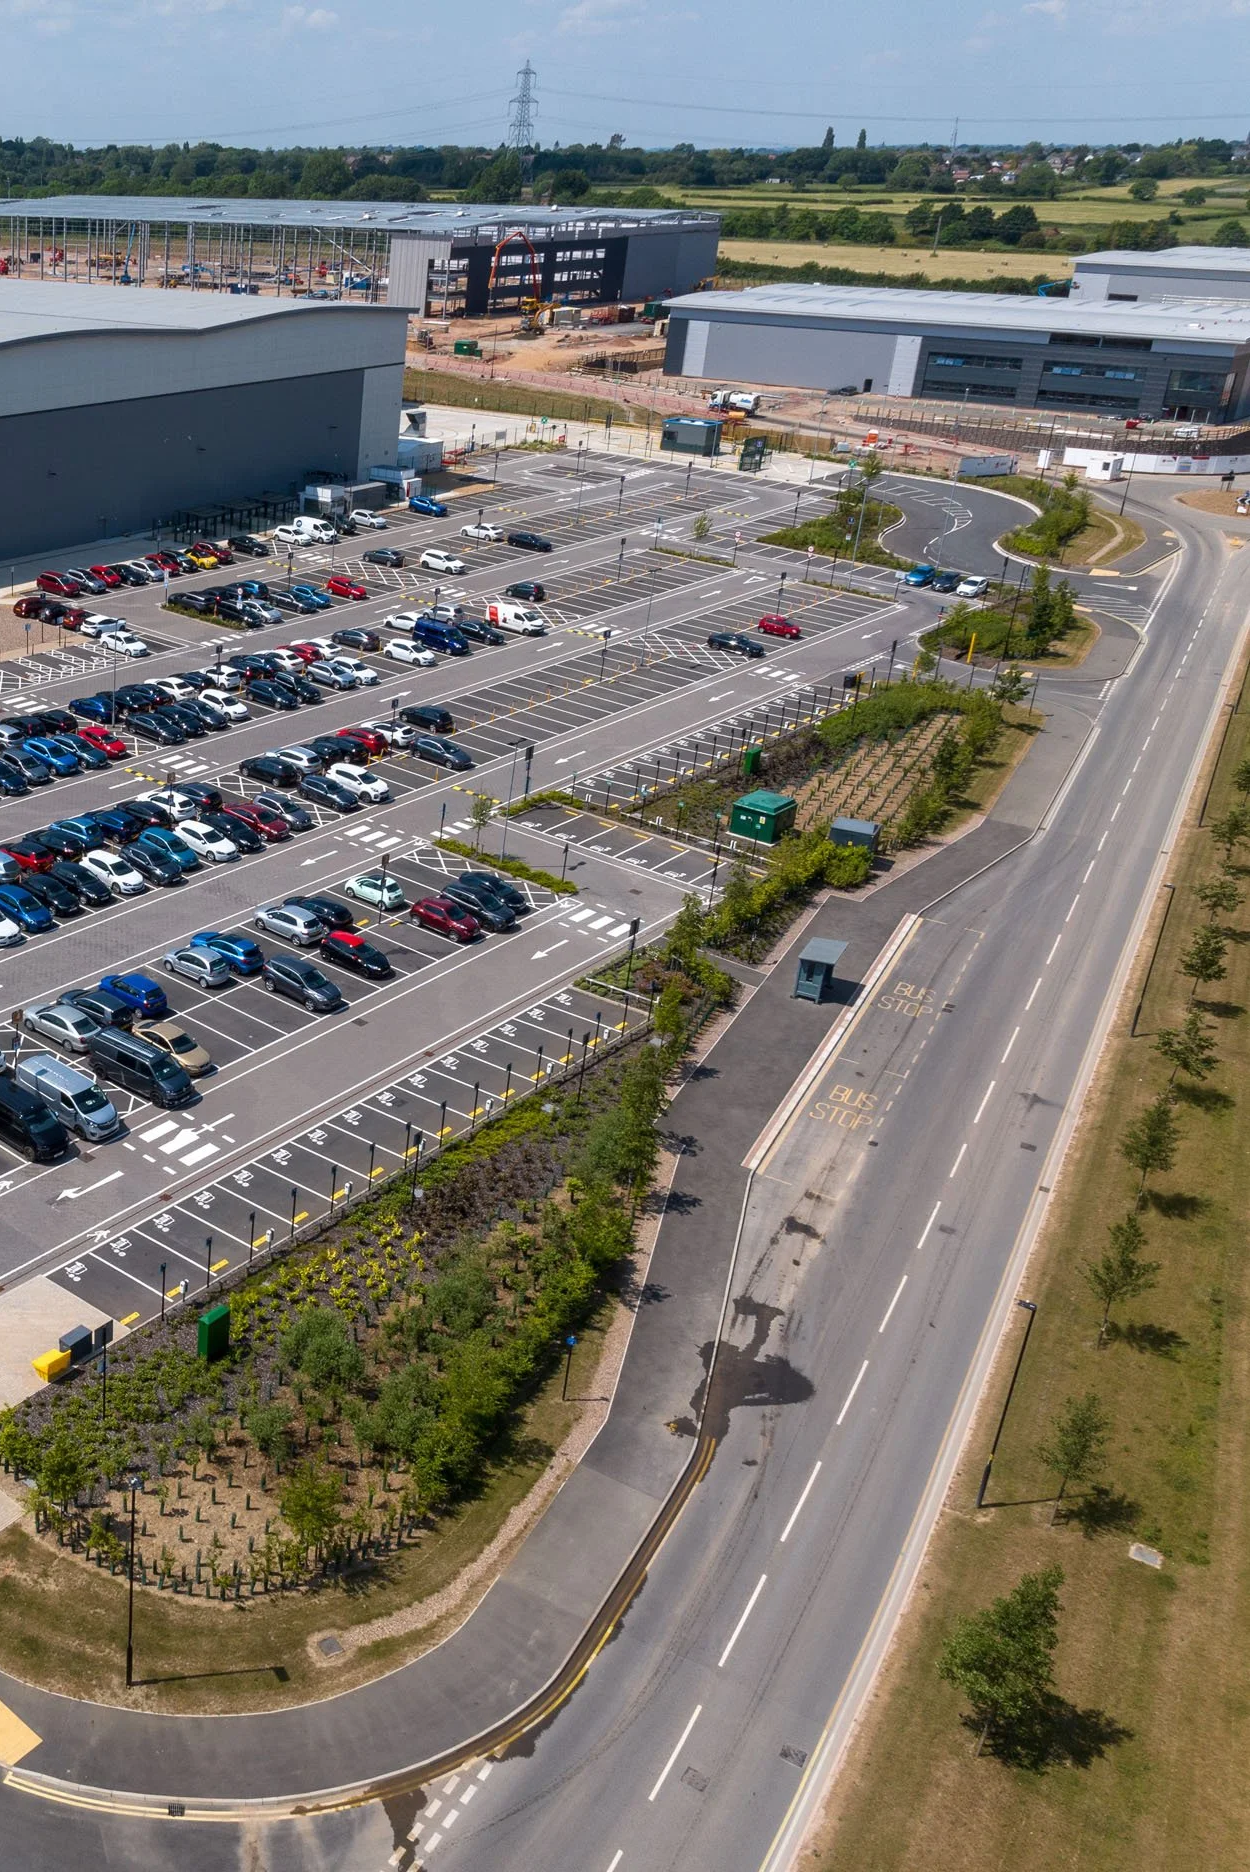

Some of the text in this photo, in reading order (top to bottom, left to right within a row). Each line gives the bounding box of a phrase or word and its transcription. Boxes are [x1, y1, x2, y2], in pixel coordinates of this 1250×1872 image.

[893, 982, 937, 1003] BUS
[877, 995, 934, 1018] STOP
[829, 1084, 878, 1111] BUS
[809, 1102, 873, 1129] STOP
